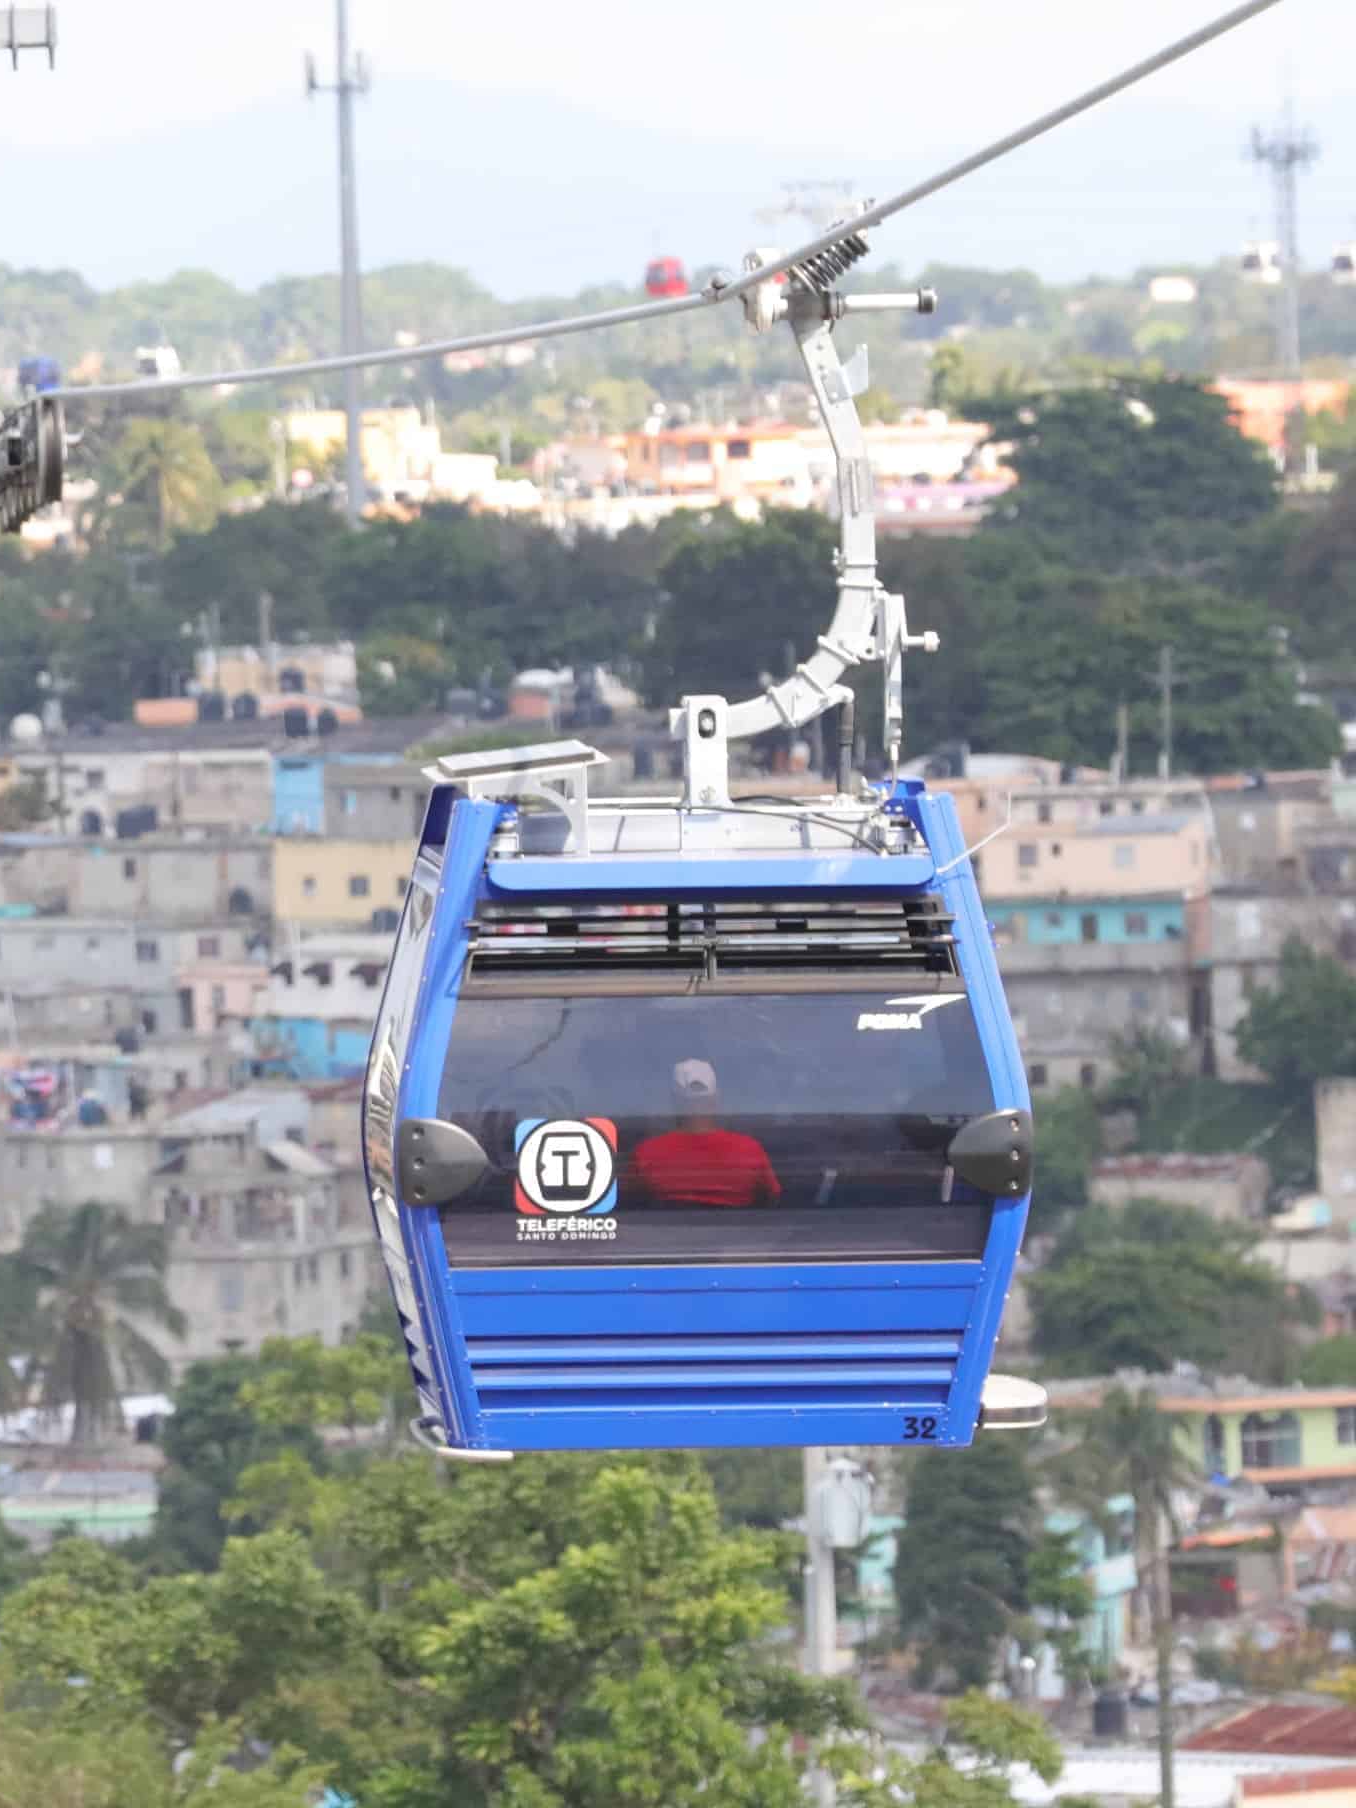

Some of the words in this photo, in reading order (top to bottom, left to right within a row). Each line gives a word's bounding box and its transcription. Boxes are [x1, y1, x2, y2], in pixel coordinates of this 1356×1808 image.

[516, 1215, 618, 1232] TELEFÉRICO
[516, 1232, 556, 1241] SANTO
[902, 1416, 937, 1440] 32
